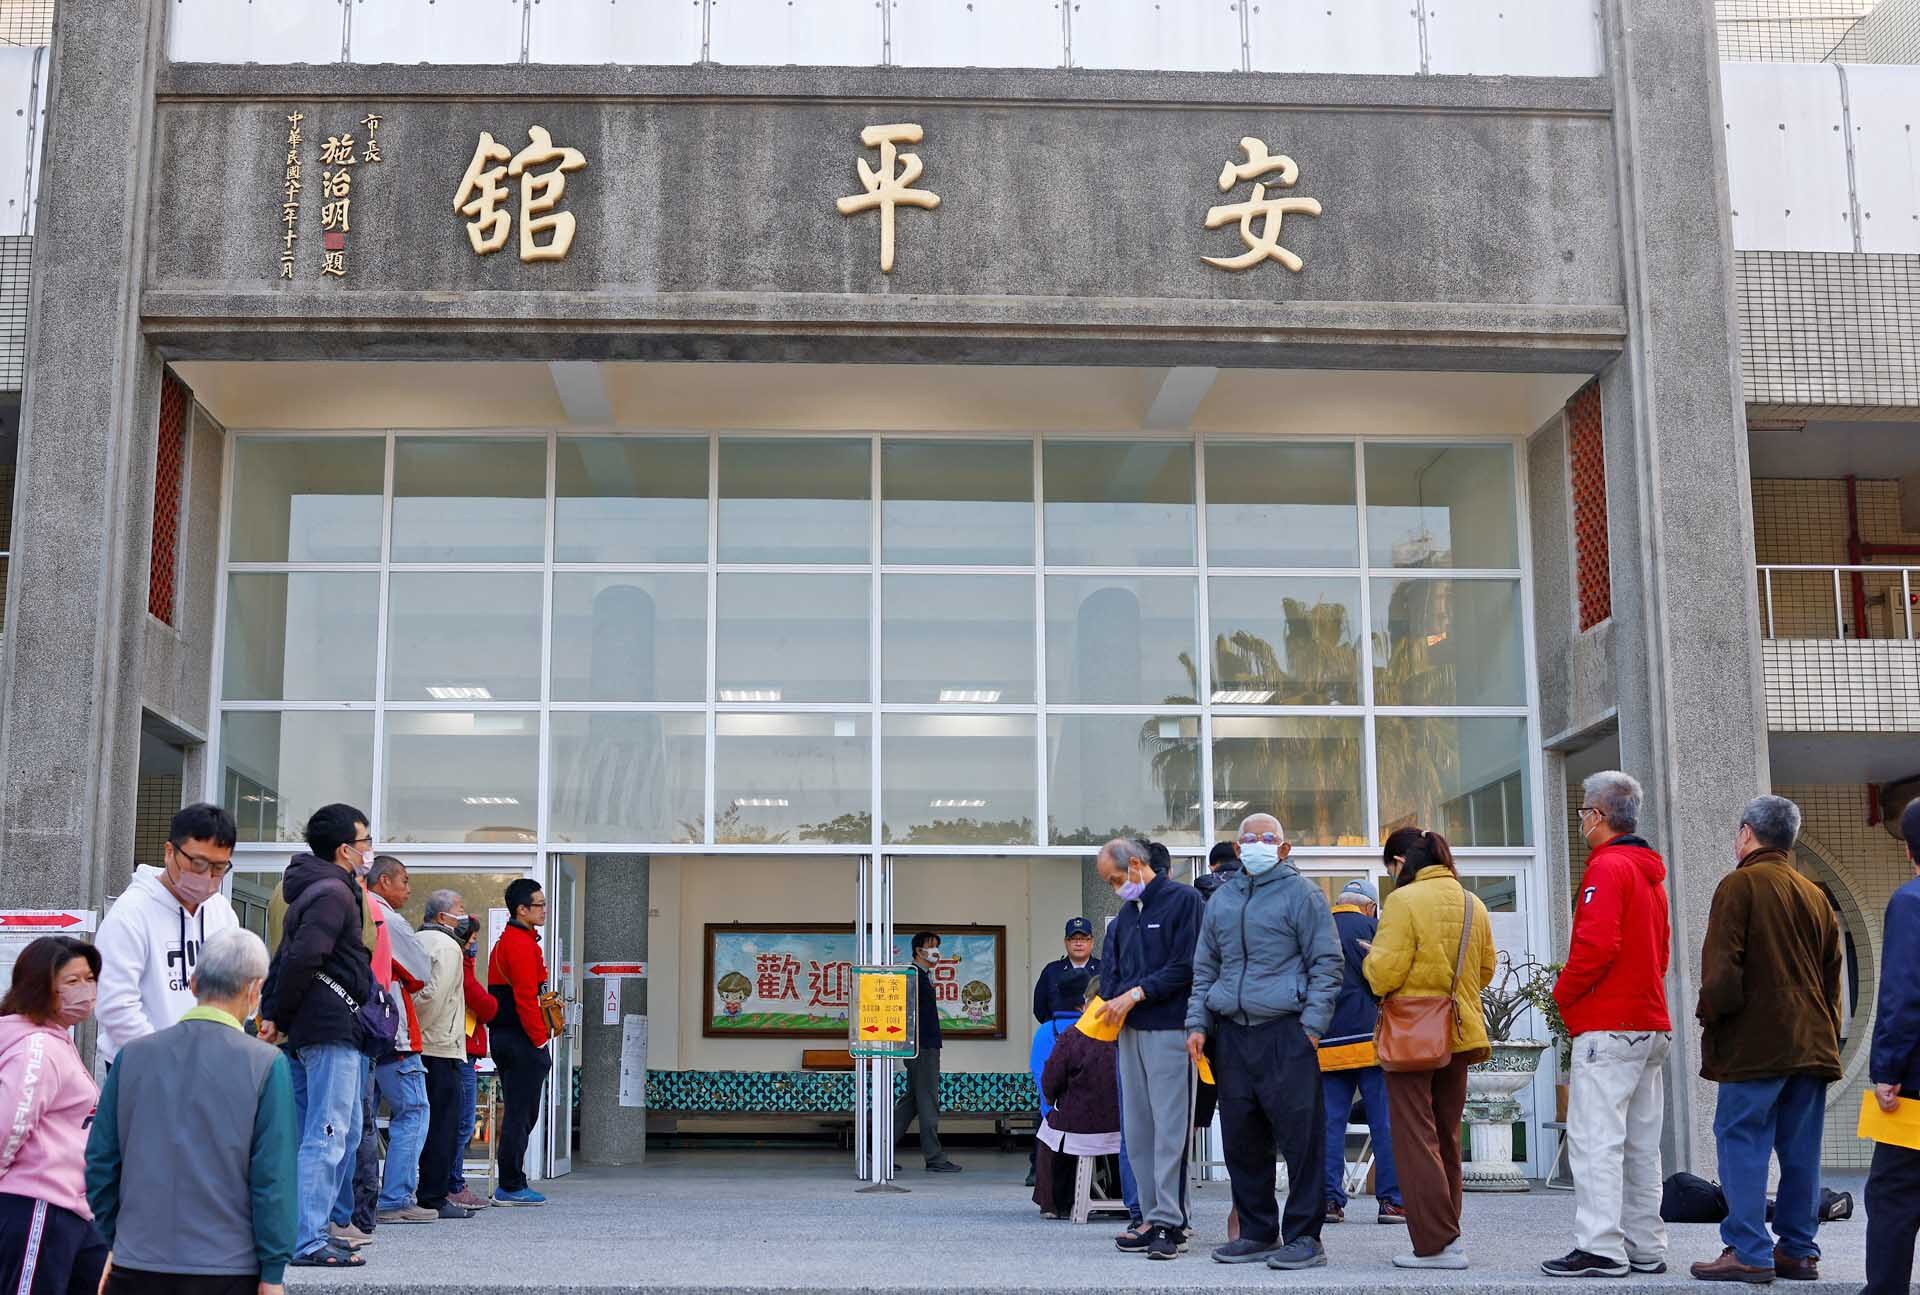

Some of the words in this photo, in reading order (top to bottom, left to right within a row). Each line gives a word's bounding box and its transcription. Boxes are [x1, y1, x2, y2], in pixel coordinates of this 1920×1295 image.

[360, 113, 384, 162] 市長
[280, 109, 304, 279] 中華民國八十一年十二月
[319, 133, 357, 232] 施治明
[607, 991, 618, 1012] 入口
